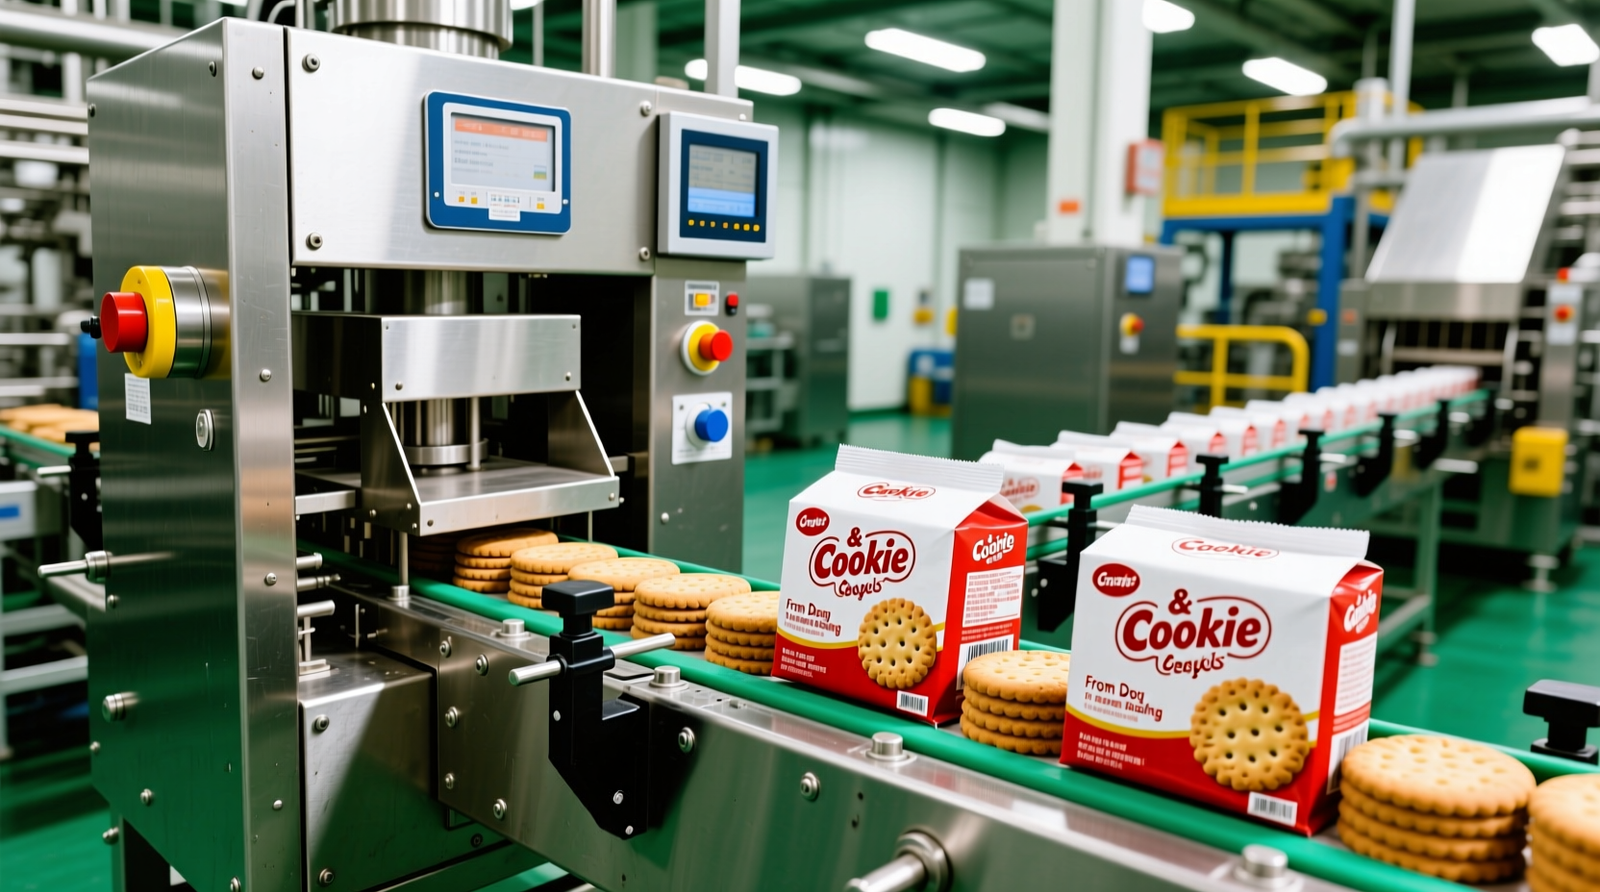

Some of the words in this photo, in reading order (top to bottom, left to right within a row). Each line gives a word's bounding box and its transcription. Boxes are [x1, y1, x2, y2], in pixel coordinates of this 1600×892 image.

[847, 527, 862, 548] &
[814, 538, 909, 579] Cookie
[1168, 588, 1192, 615] &
[1123, 606, 1261, 652] Cookie
[1085, 675, 1115, 695] From
